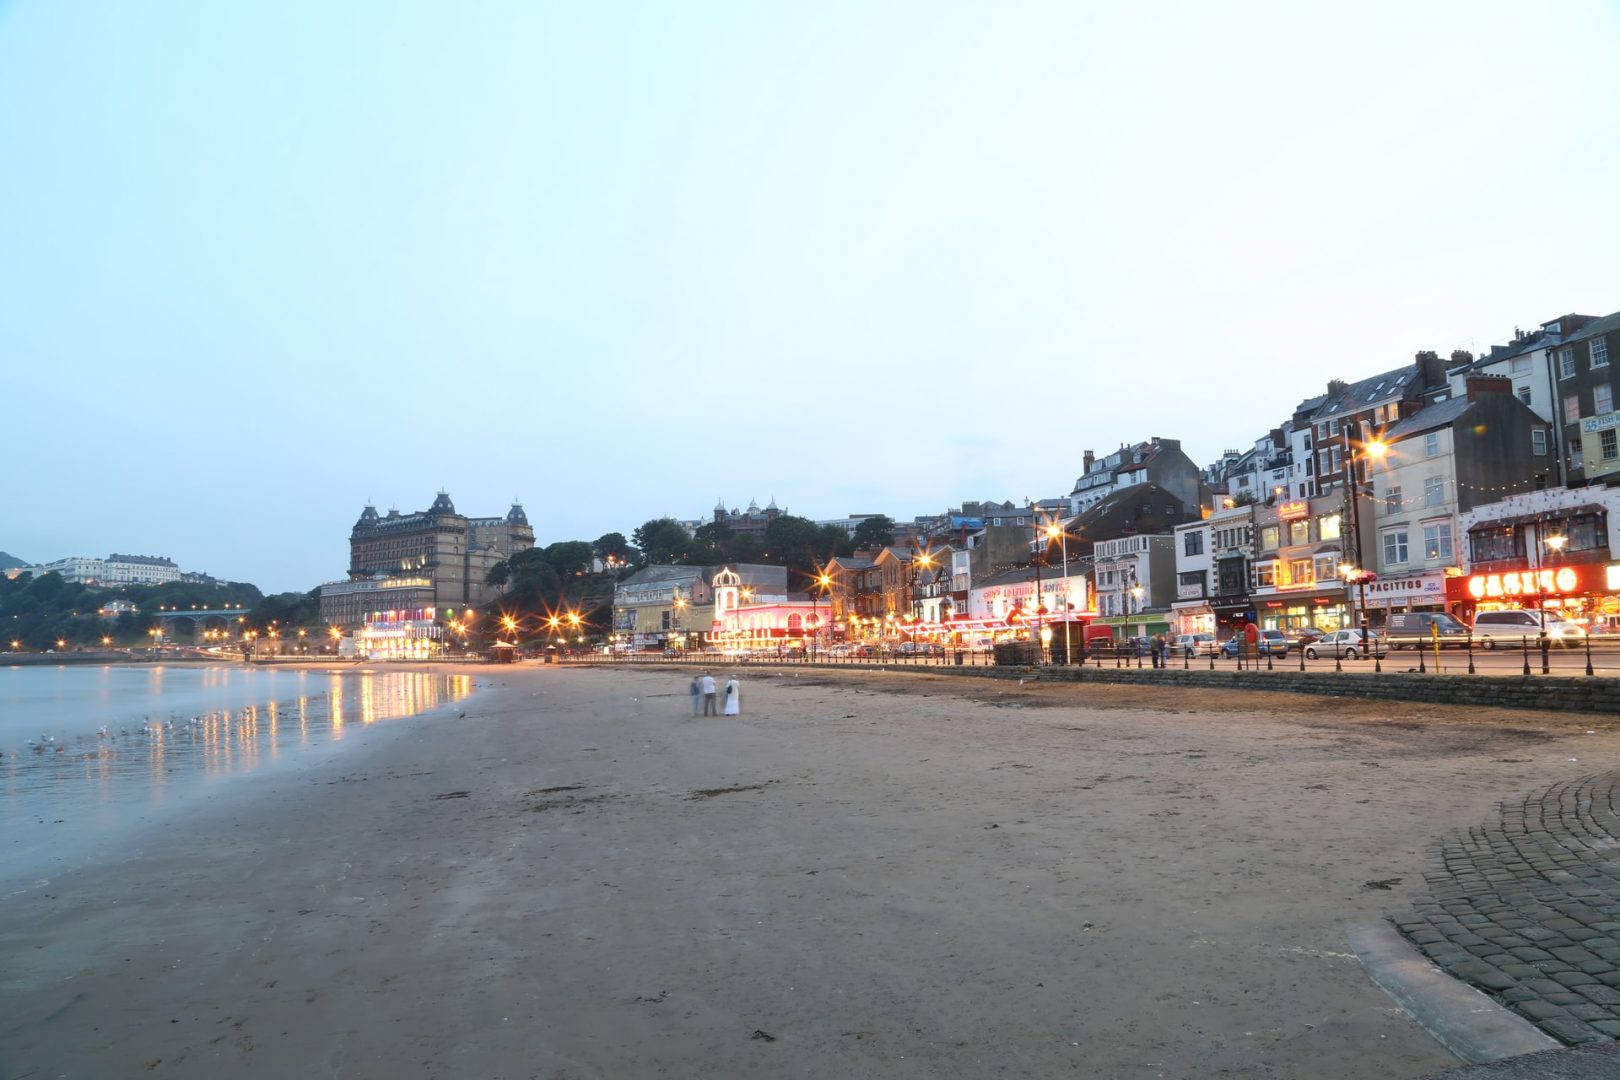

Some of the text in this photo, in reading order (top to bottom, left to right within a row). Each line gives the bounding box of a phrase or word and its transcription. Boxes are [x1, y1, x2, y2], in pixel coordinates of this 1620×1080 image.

[1584, 420, 1597, 433] 55
[1598, 416, 1614, 425] FISH
[1369, 580, 1422, 593] PACITTOS
[1468, 568, 1577, 597] CASINO
